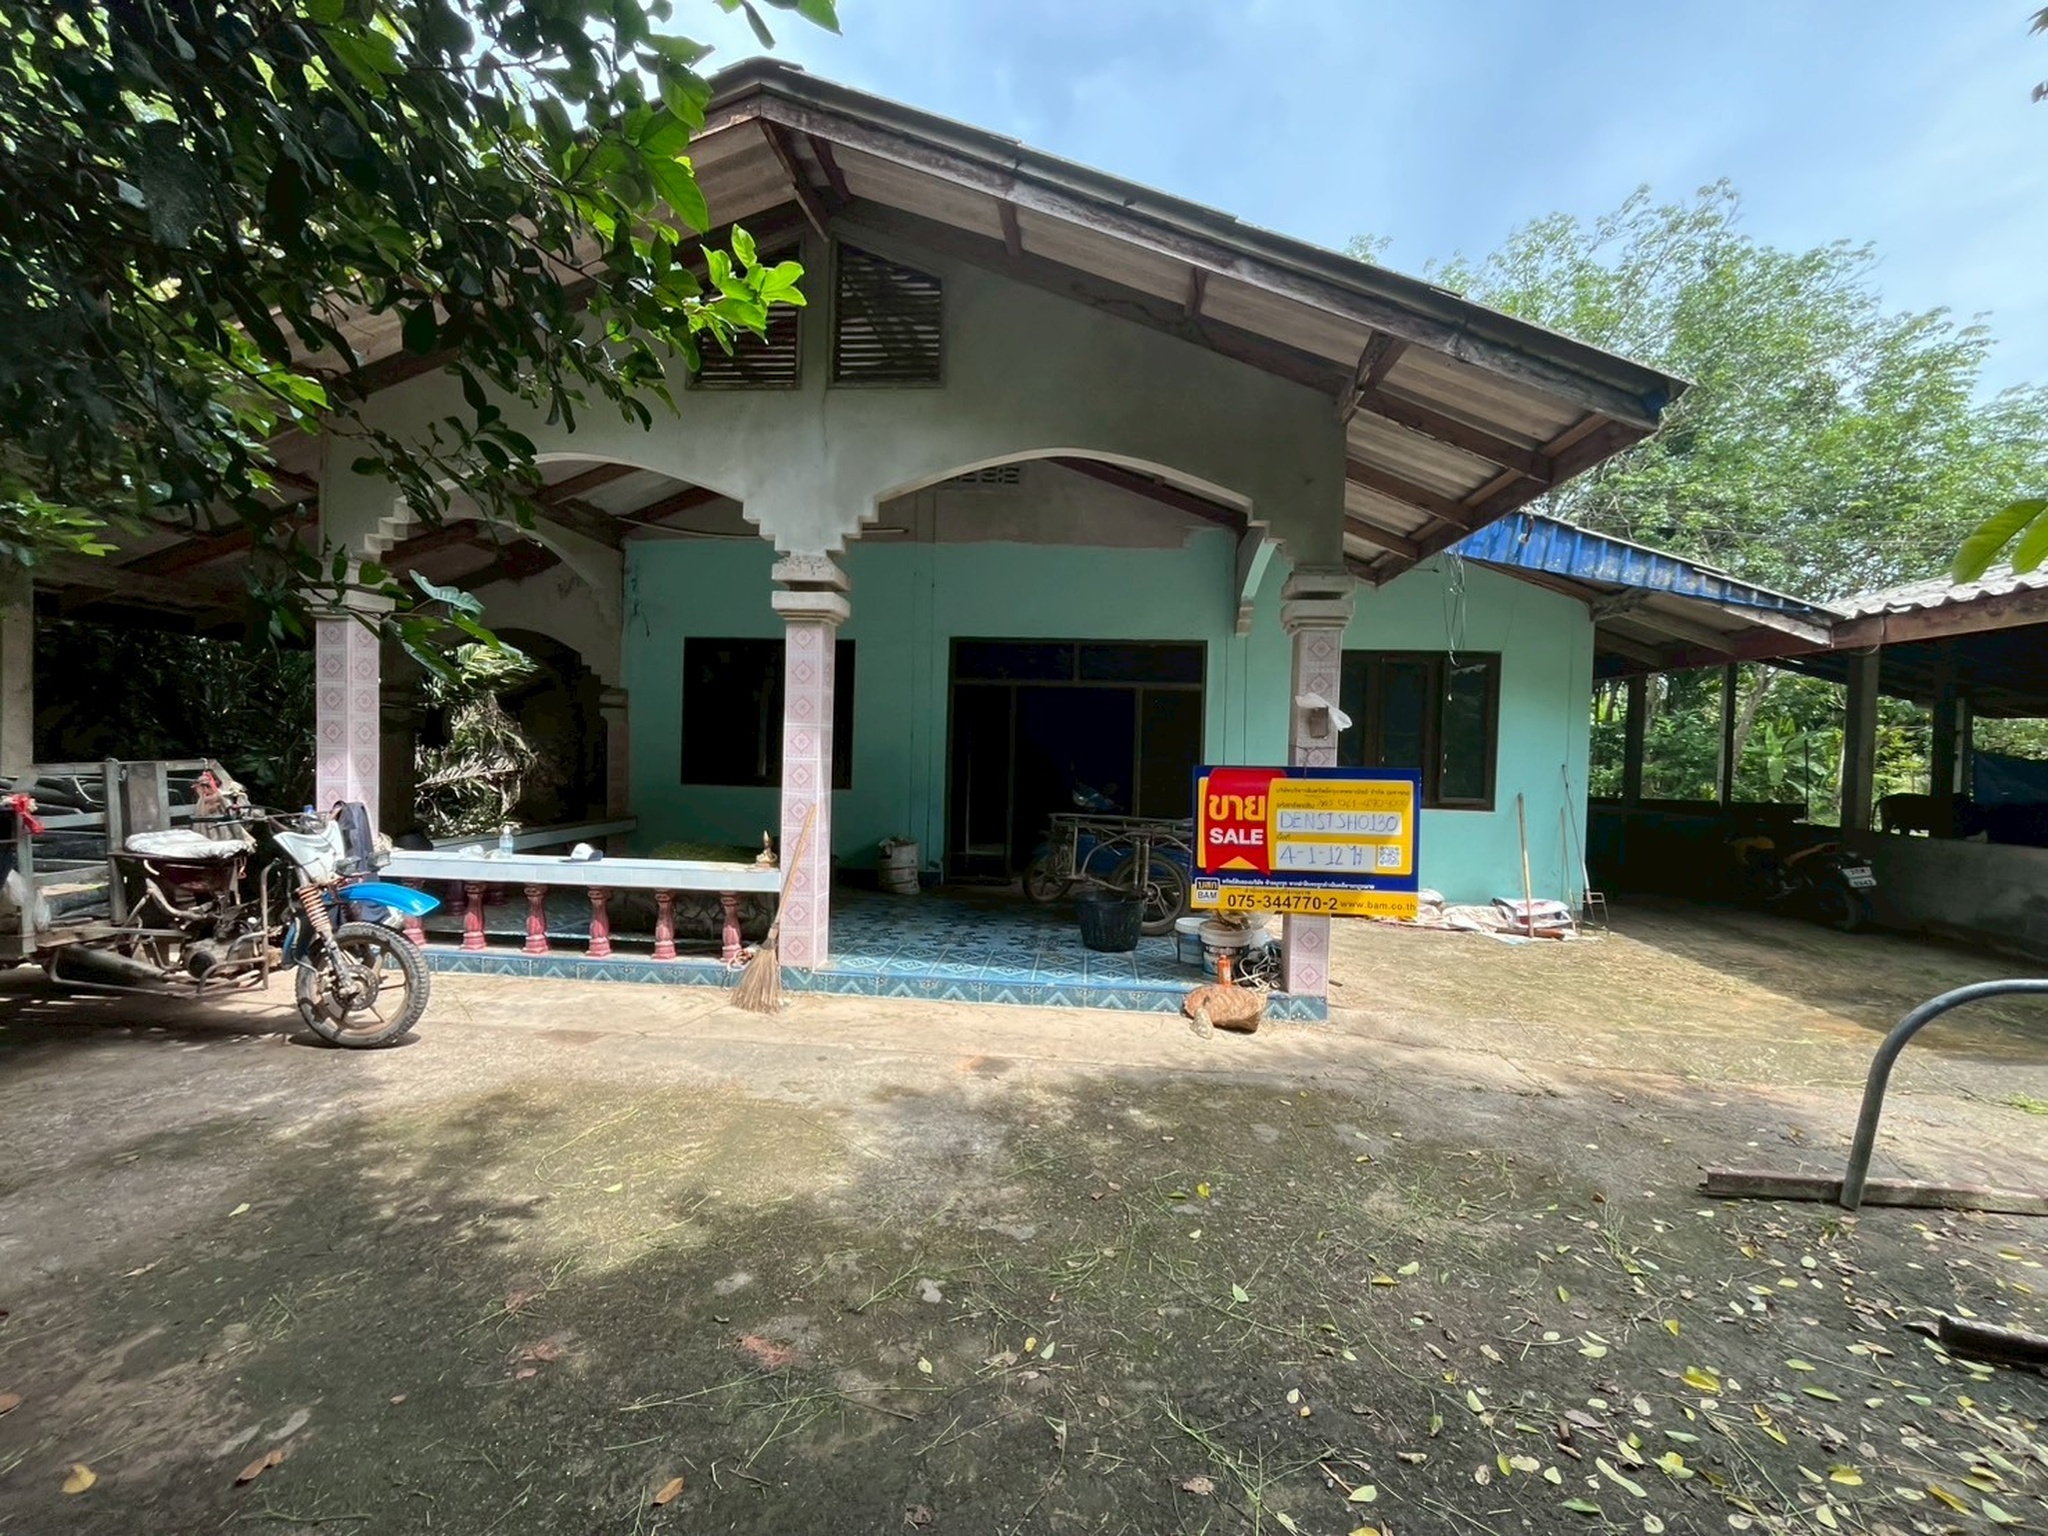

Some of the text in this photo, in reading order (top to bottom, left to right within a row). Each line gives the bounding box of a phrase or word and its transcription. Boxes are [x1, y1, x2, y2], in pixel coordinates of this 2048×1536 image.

[1209, 794, 1265, 821] ขาย
[1209, 827, 1264, 845] SALE
[1197, 891, 1217, 899] BAM
[1227, 894, 1416, 911] 075-344770-2 www.bam.co.th
